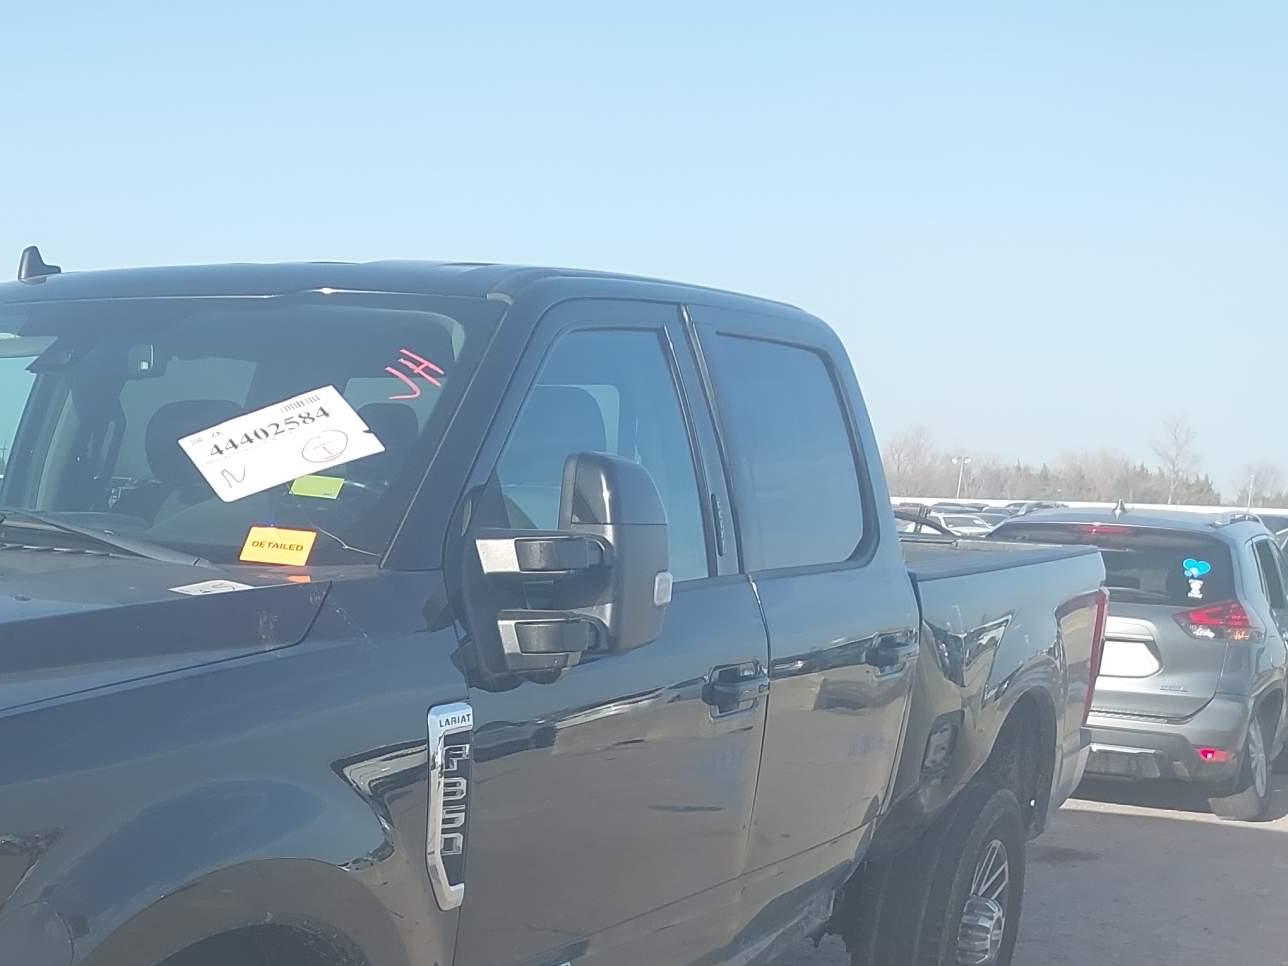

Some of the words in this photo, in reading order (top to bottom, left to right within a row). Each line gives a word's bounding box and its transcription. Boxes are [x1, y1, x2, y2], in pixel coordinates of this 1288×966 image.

[209, 405, 332, 457] 44402584
[251, 540, 304, 551] DETAILED
[438, 713, 472, 728] LARIAT
